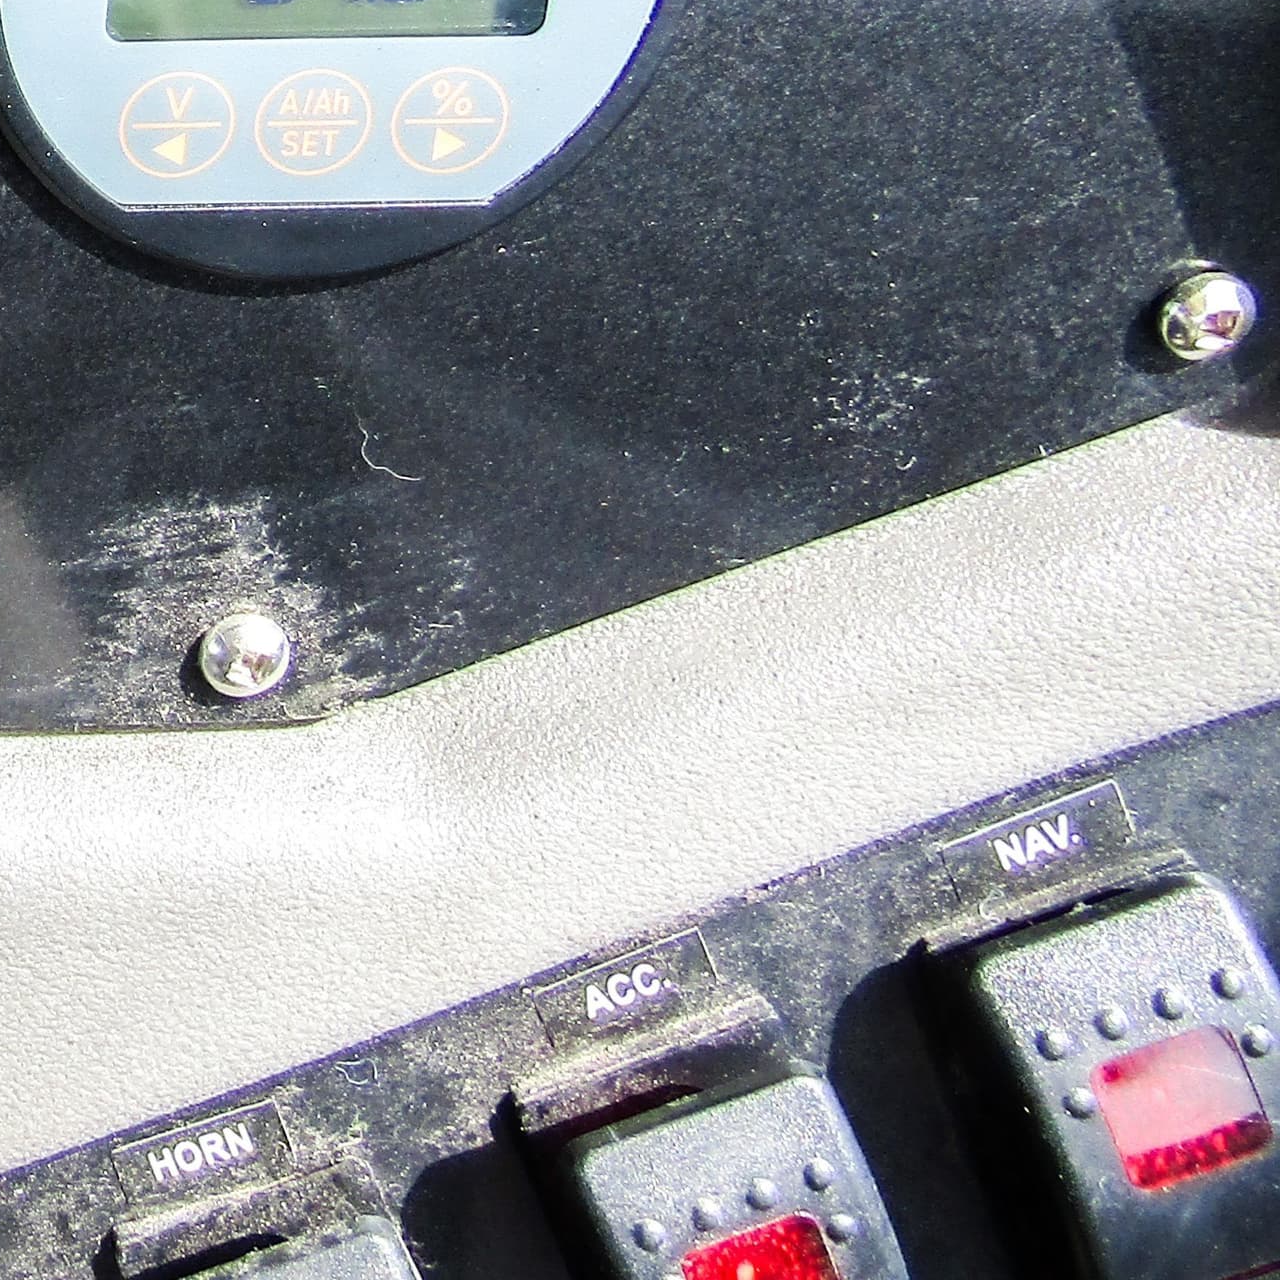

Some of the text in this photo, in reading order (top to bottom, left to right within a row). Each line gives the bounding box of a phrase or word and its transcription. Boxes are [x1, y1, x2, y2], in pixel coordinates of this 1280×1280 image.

[165, 86, 193, 121] V
[278, 87, 352, 116] A/Ah
[280, 128, 340, 158] SET
[993, 813, 1082, 871] NAV.
[585, 963, 671, 1020] ACC.
[147, 1122, 254, 1182] HORN
